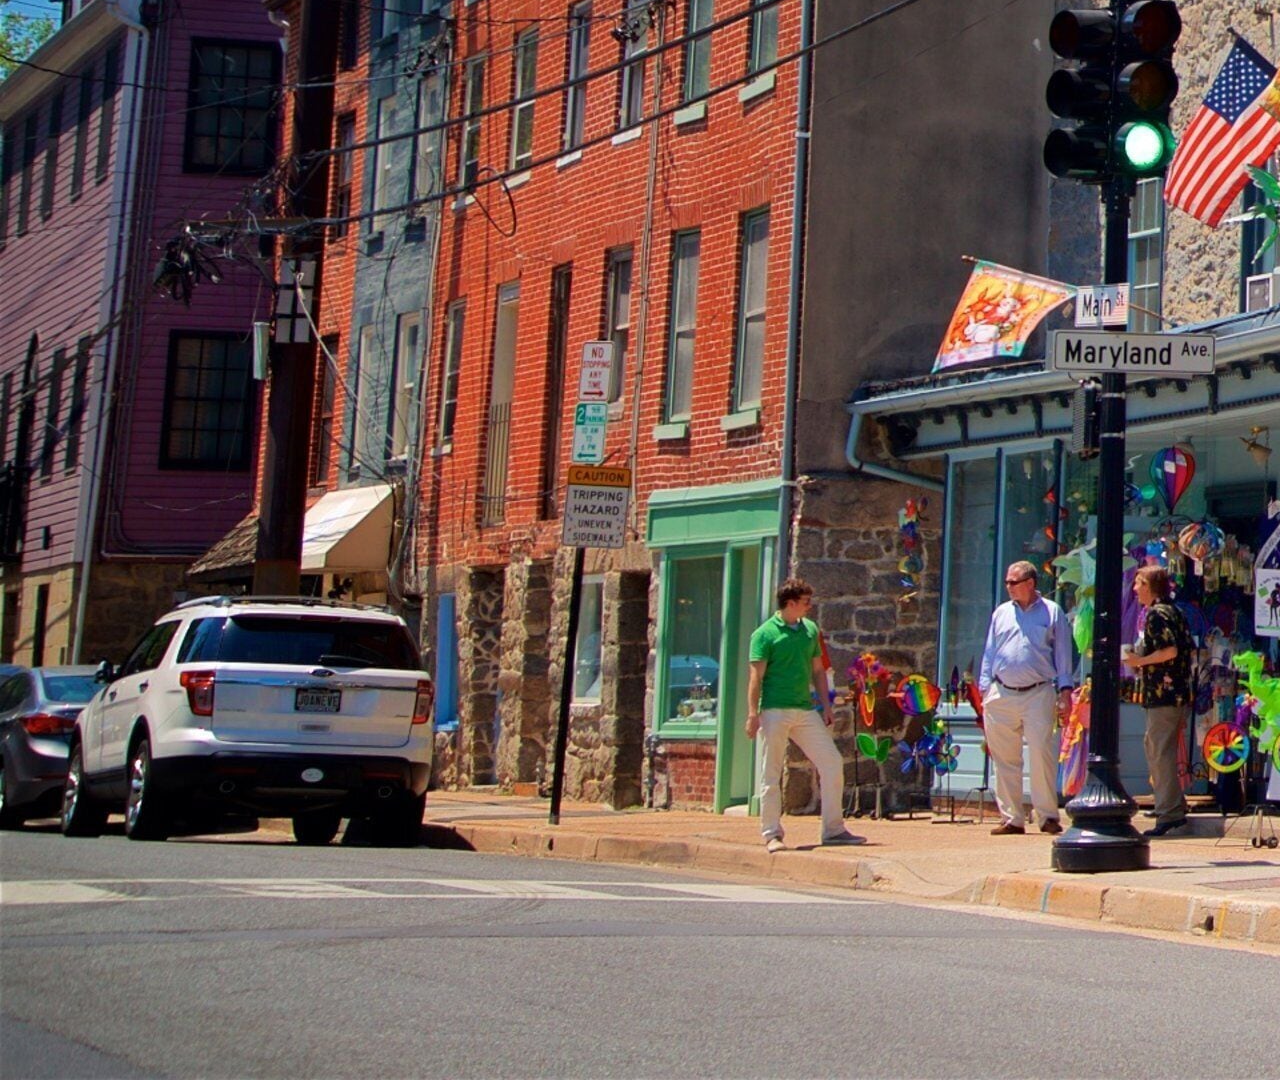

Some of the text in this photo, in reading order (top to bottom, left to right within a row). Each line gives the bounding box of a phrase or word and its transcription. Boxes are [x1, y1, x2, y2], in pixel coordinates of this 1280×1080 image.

[1082, 293, 1112, 317] Main
[592, 347, 604, 358] NO
[1065, 339, 1210, 368] Maryland Ave.
[577, 407, 585, 422] 2
[576, 471, 625, 482] CAUTION
[573, 489, 623, 502] TRIPPING
[573, 504, 620, 516] HAZARD
[578, 520, 612, 529] UNEVEN
[573, 532, 614, 542] SIDEWALK
